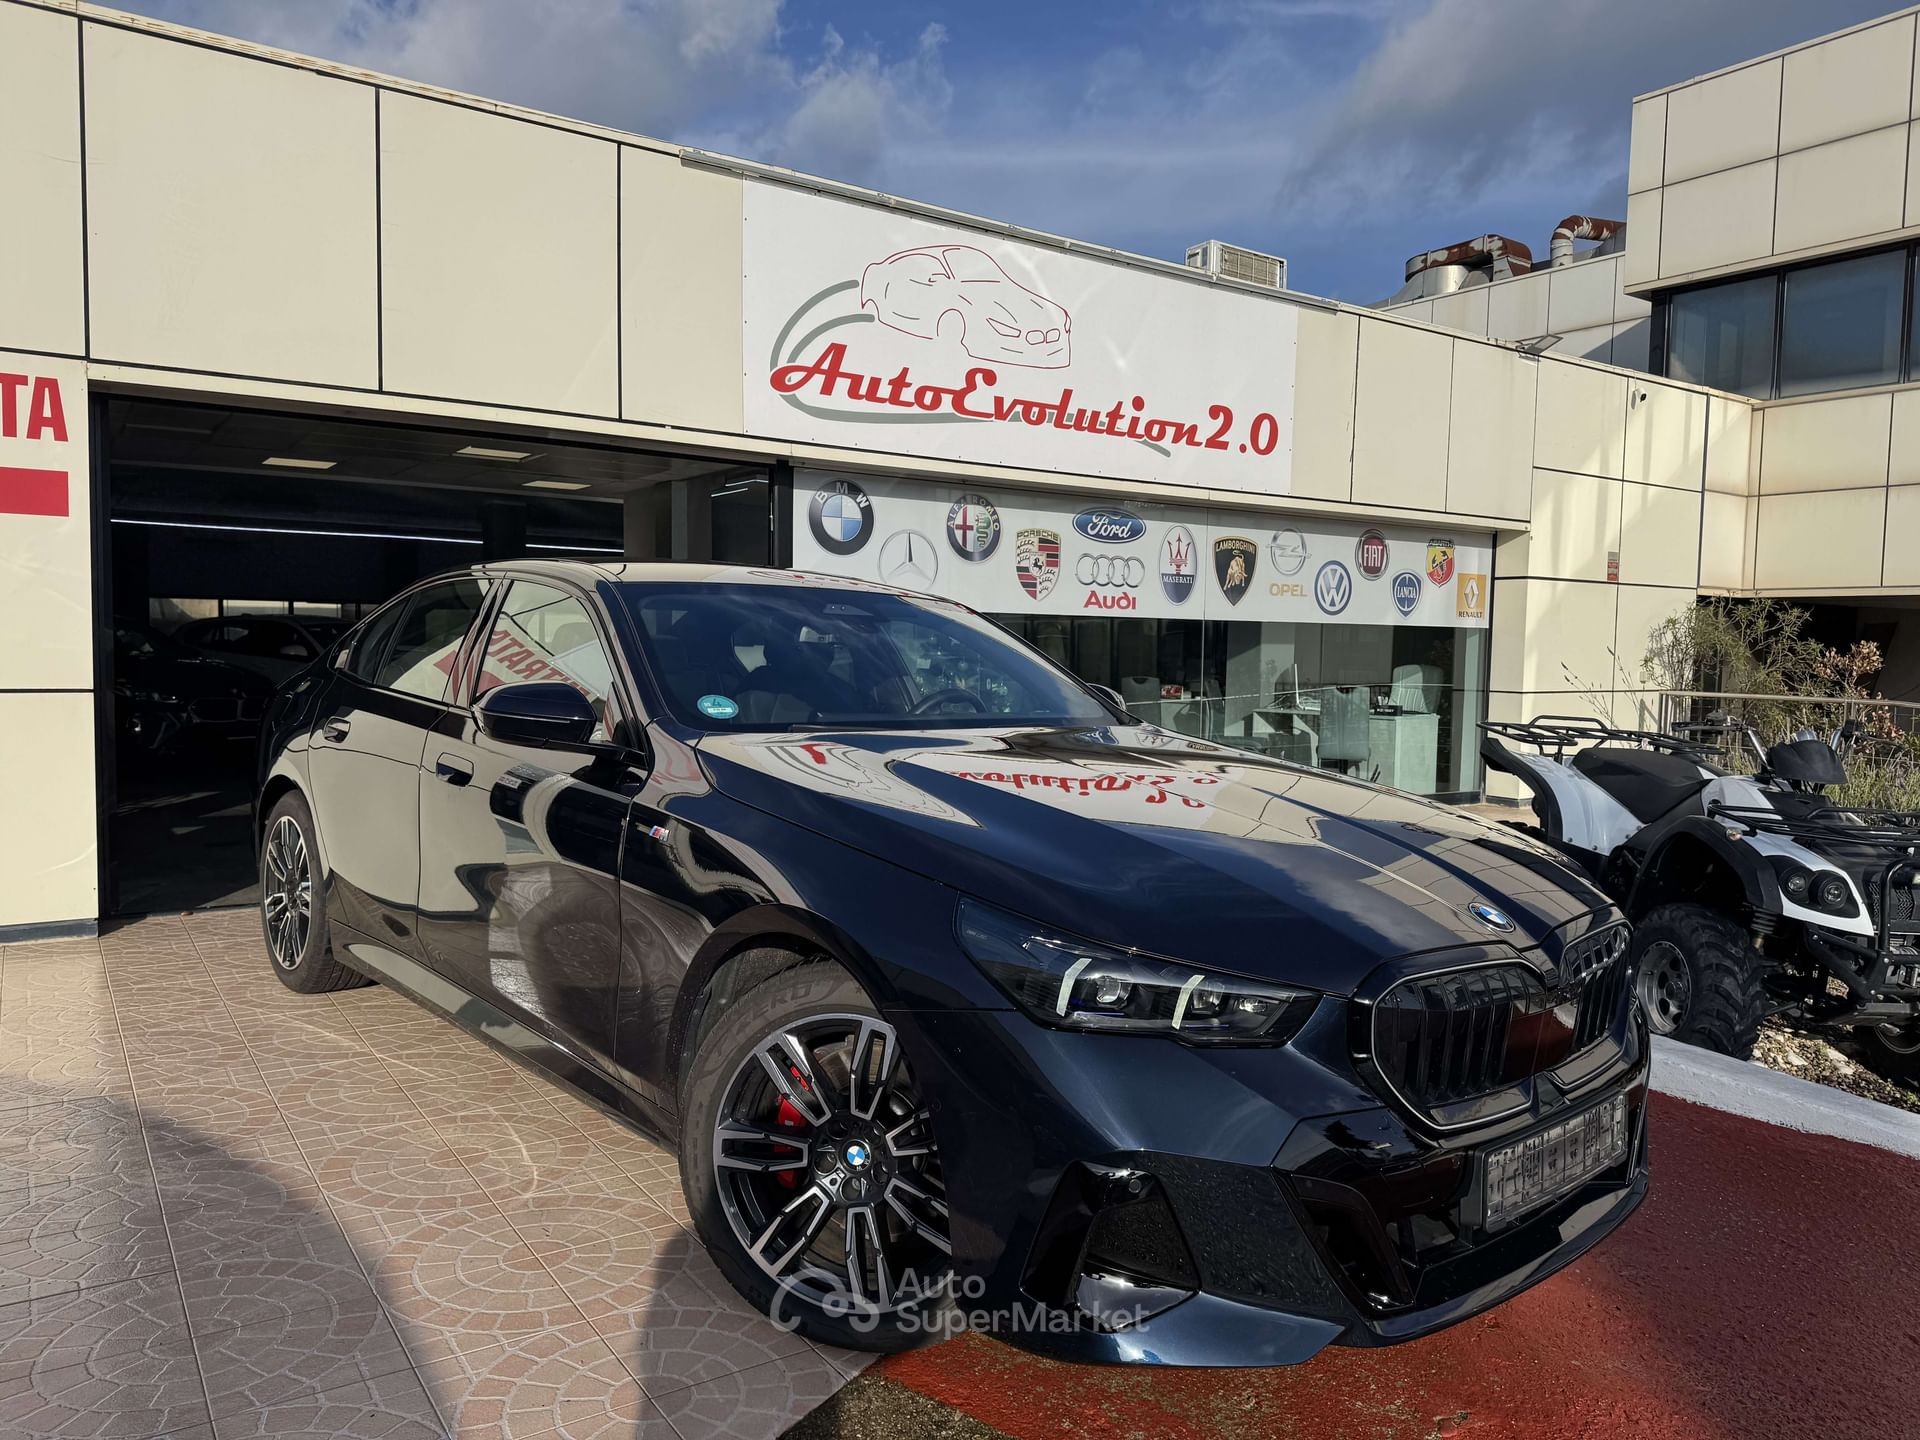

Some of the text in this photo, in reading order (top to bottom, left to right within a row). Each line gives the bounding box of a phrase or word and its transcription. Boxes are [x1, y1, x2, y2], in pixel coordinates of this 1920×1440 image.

[0, 373, 69, 442] TA
[815, 481, 870, 508] BMW
[1087, 512, 1133, 538] Ford
[1216, 540, 1256, 554] LAMBORGHINI
[1363, 544, 1384, 568] FIAT
[1163, 575, 1193, 584] MASERATI
[1270, 583, 1308, 598] OPEL
[1397, 586, 1417, 598] LANCIA
[1083, 590, 1137, 610] Audi
[1458, 610, 1483, 618] RENAULT
